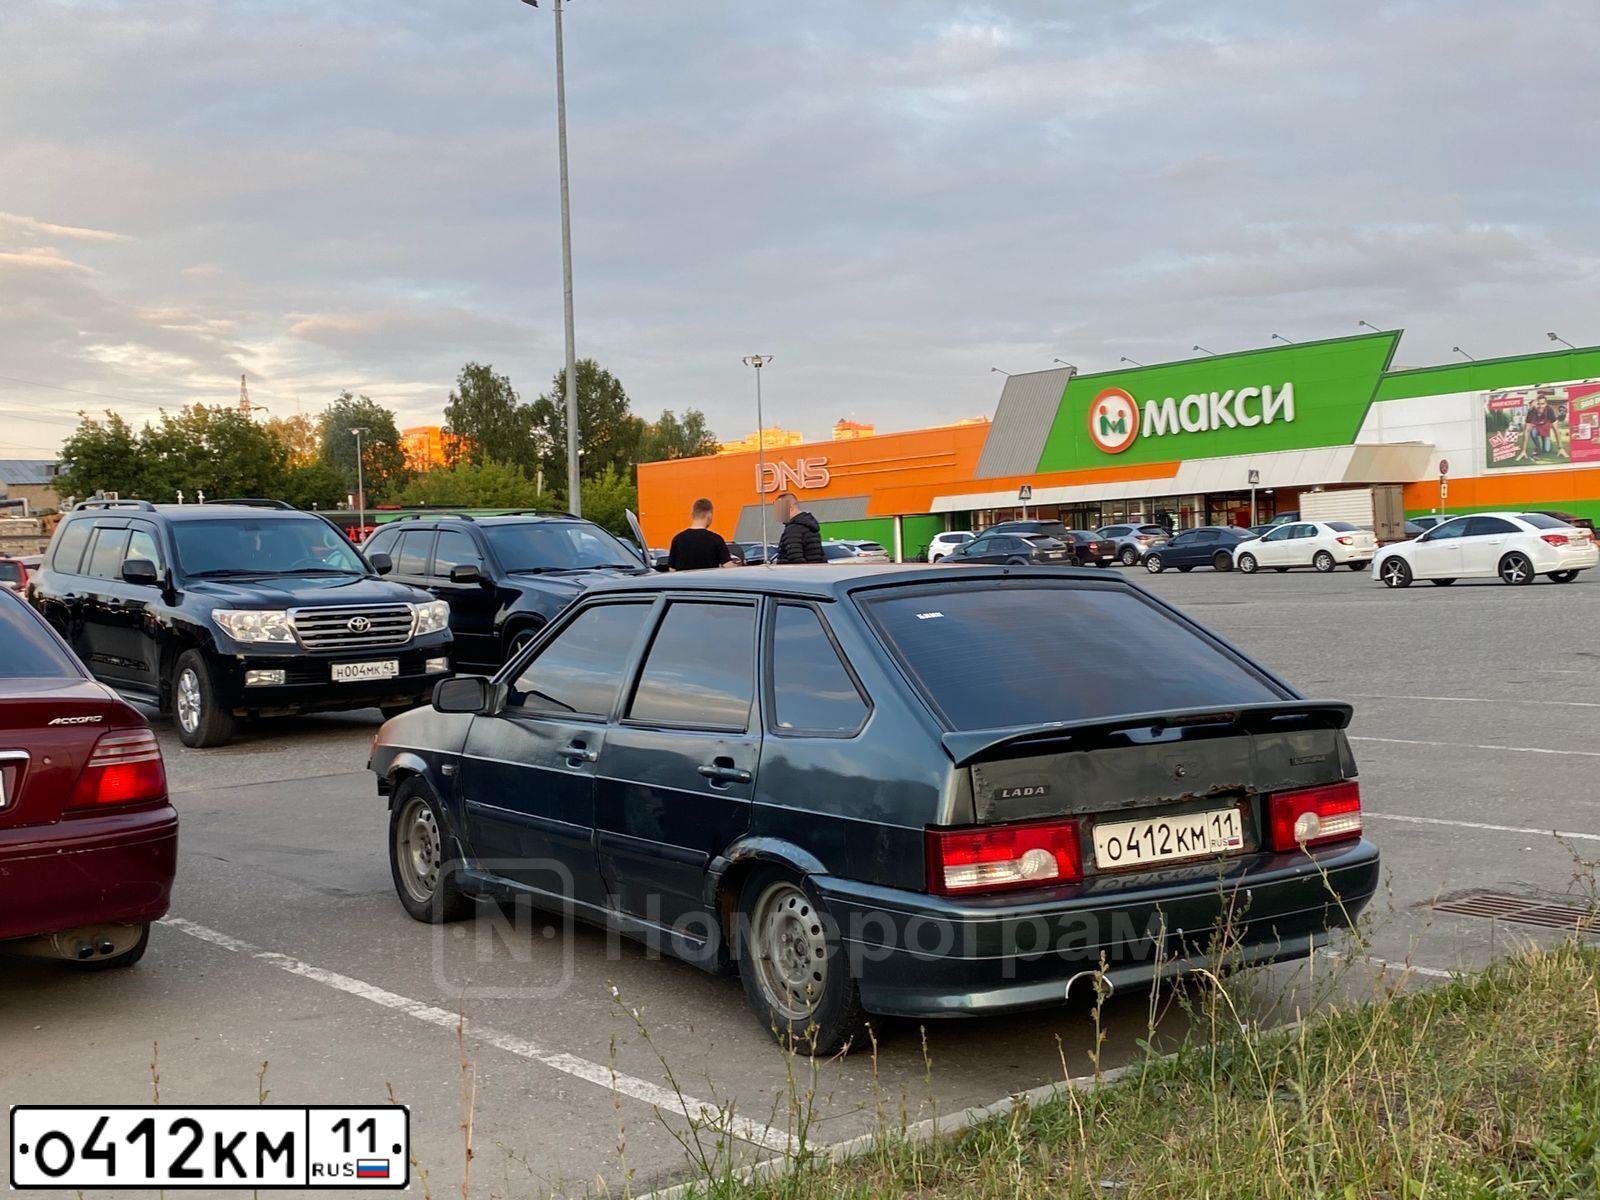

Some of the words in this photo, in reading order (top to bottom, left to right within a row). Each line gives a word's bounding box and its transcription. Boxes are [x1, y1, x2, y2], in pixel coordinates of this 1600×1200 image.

[755, 456, 830, 493] DNS
[48, 715, 102, 725] ACCORD
[1002, 786, 1045, 798] LADA
[1107, 823, 1206, 861] О412КМ
[1212, 813, 1233, 838] 11
[1211, 839, 1228, 847] RUS
